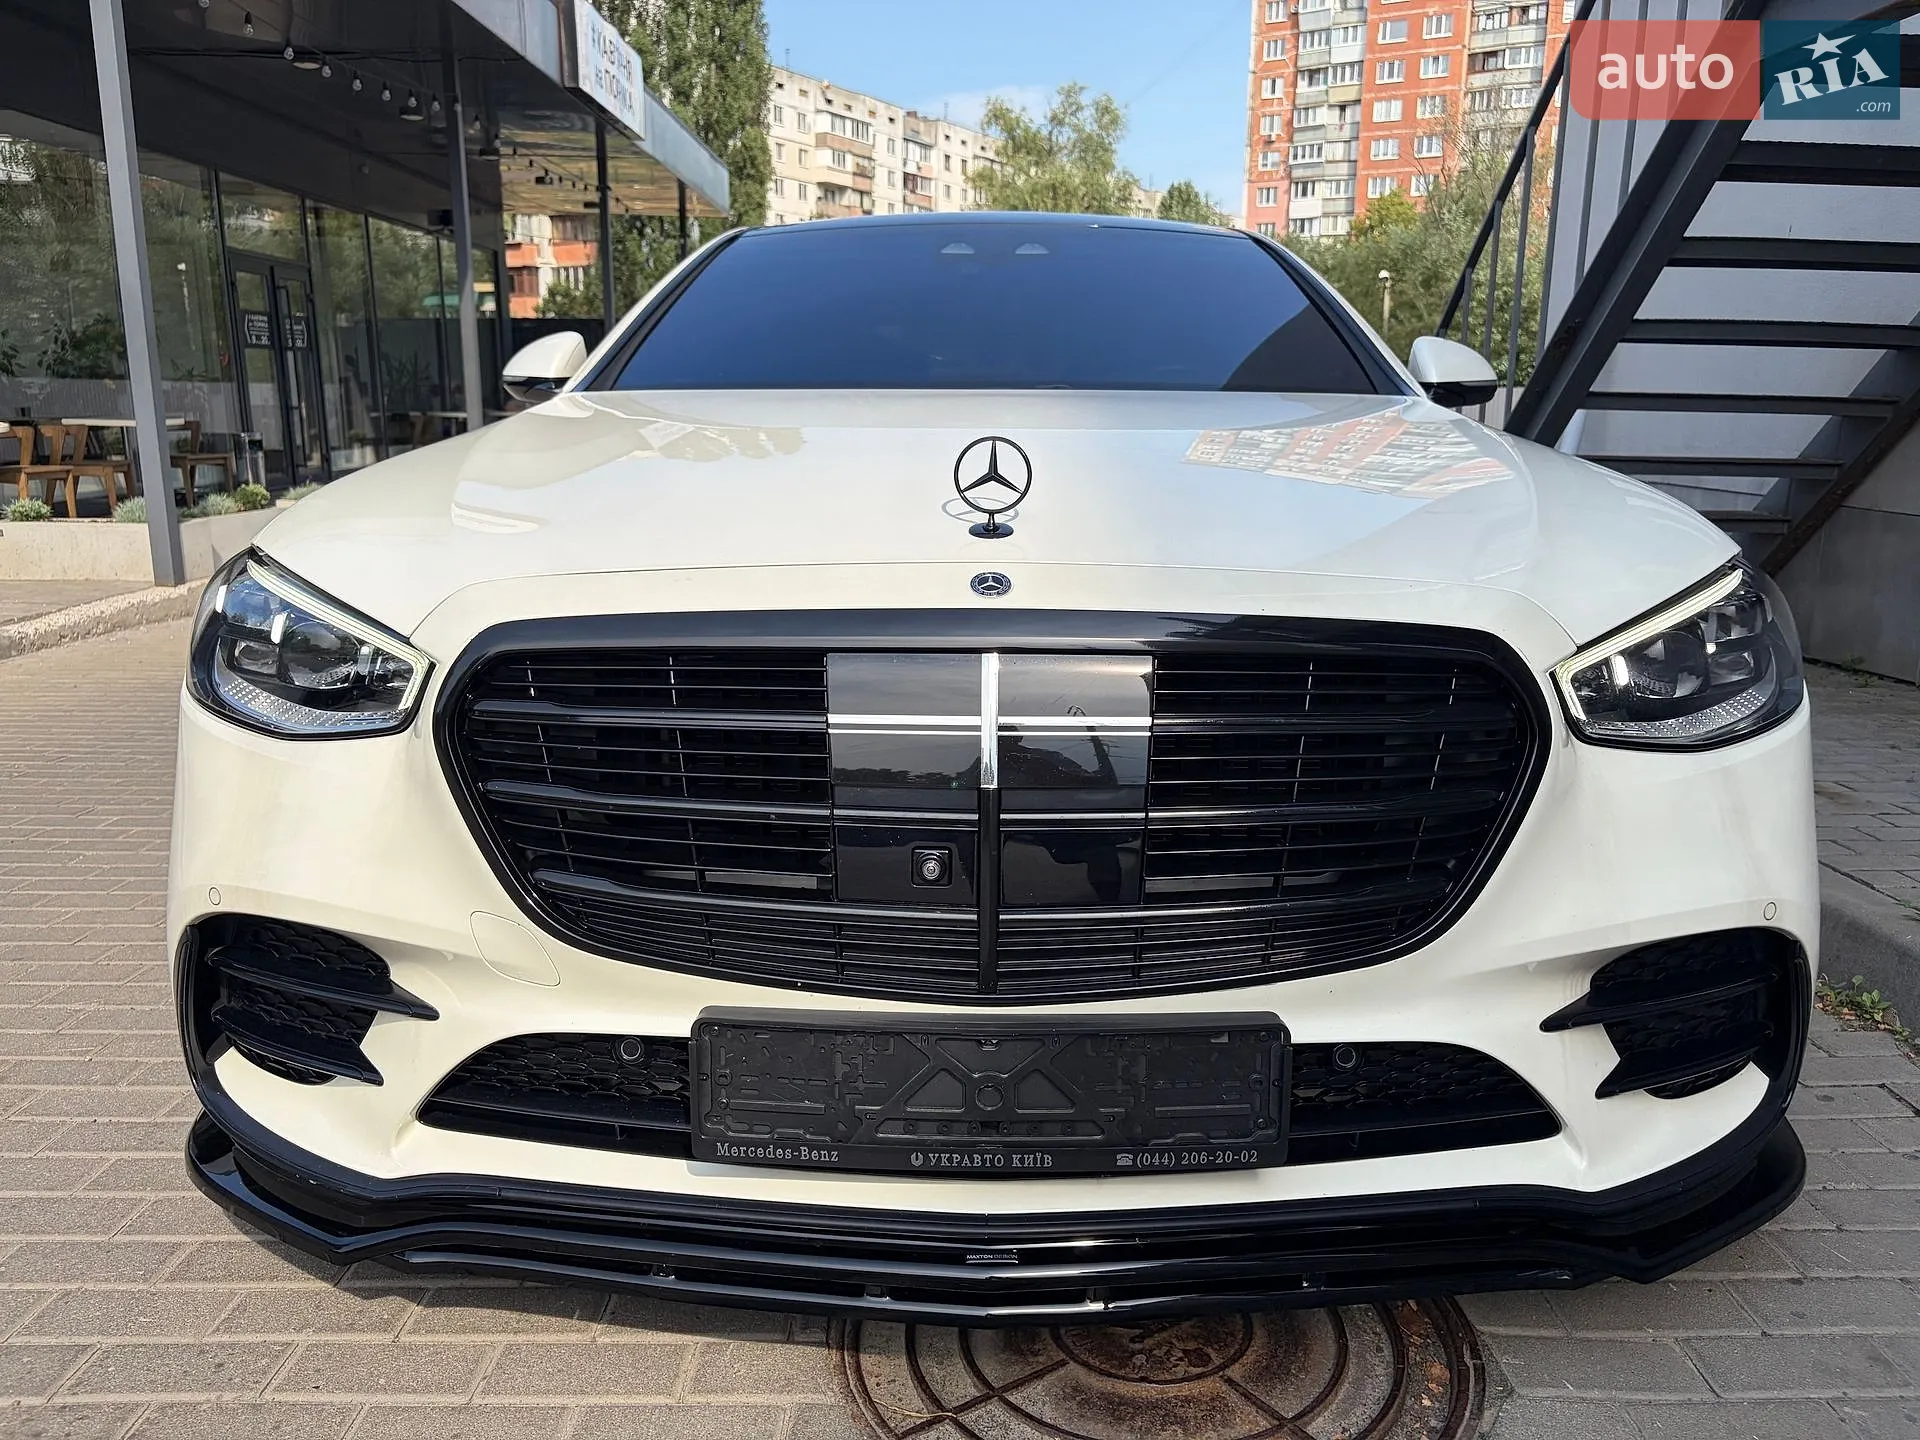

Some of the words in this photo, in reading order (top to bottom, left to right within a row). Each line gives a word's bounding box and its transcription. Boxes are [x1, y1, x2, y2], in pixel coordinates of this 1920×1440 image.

[716, 1142, 839, 1162] Mercedes-Benz
[928, 1153, 1004, 1167] УКРАВТО
[1012, 1152, 1053, 1167] КИЇВ
[1137, 1151, 1175, 1168] (044)
[1181, 1150, 1258, 1165] 206-20-02
